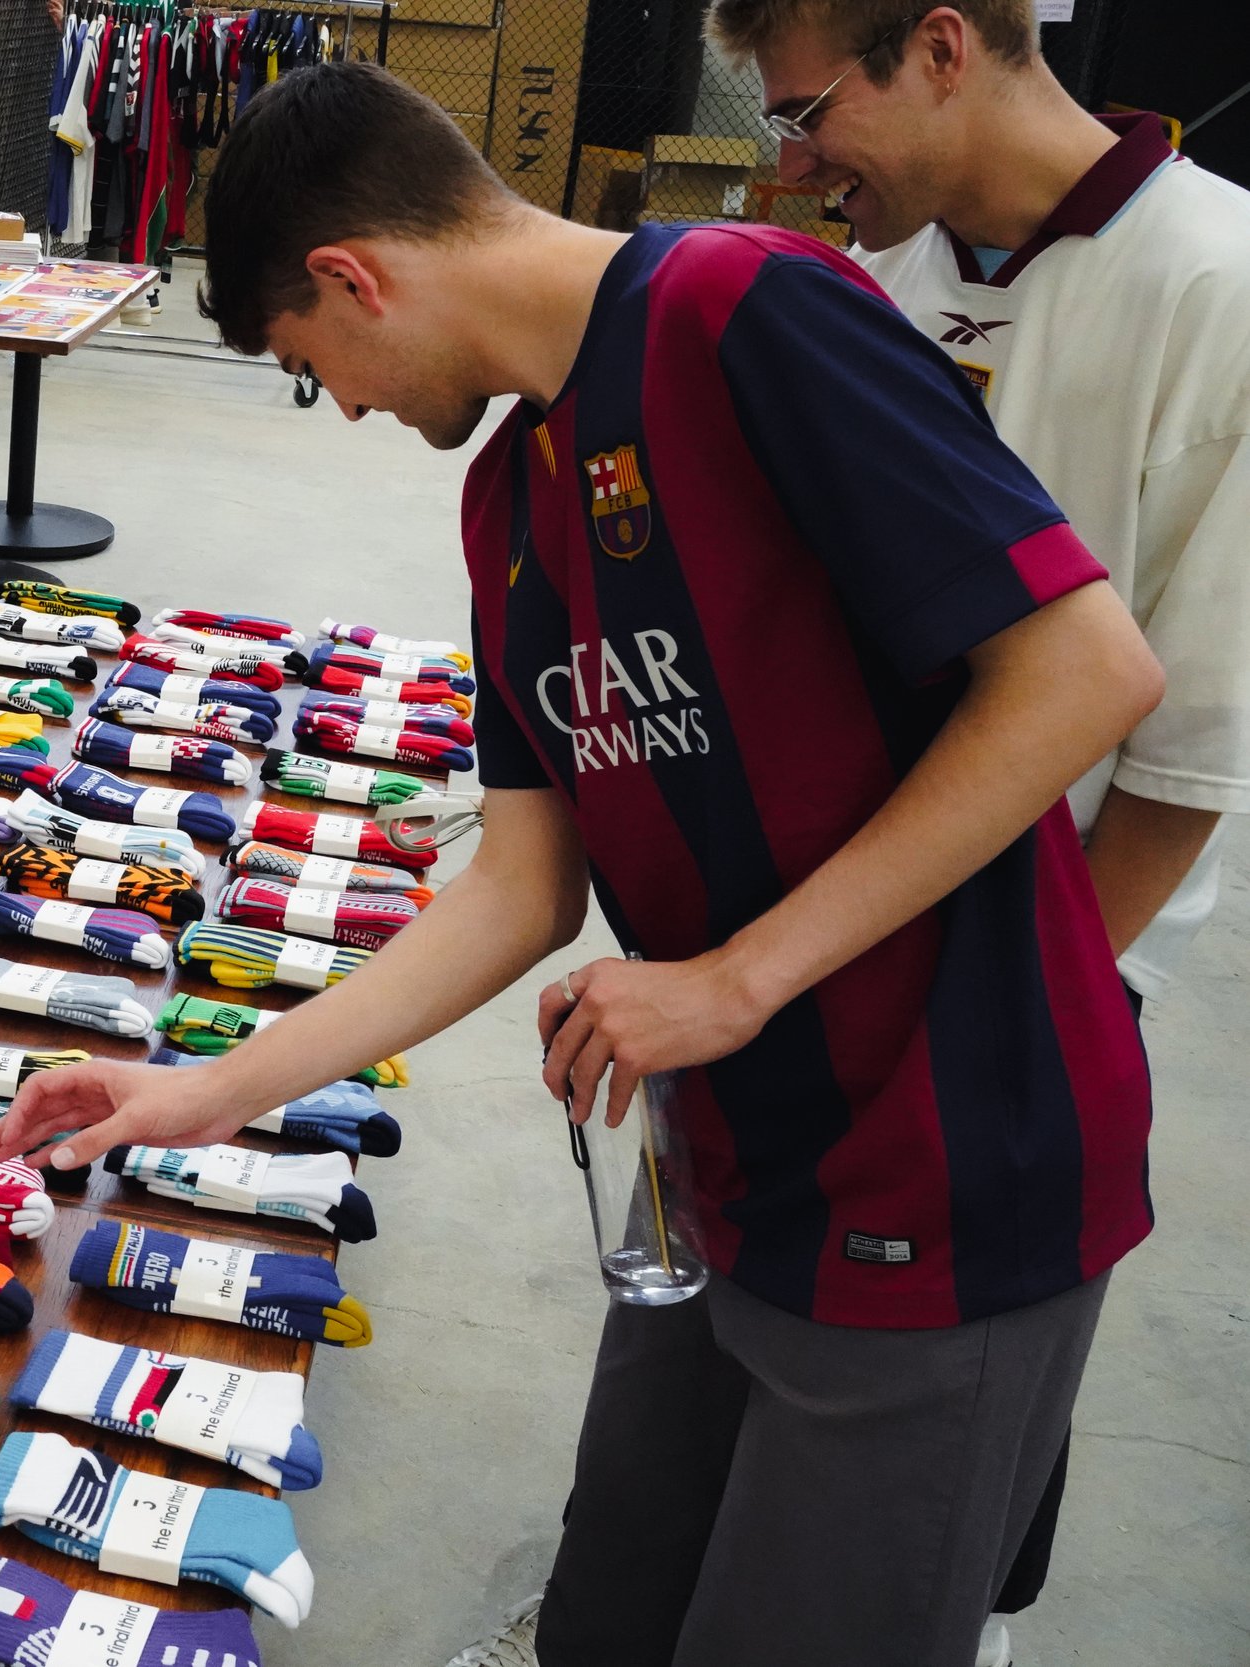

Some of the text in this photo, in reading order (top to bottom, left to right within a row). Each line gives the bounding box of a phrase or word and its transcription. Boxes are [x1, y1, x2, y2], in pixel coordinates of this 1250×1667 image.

[608, 494, 632, 512] FCB
[237, 1173, 250, 1185] the
[127, 1231, 141, 1258] ITALIA
[219, 1279, 233, 1298] the
[200, 1373, 241, 1439] the final third
[152, 1485, 187, 1550] the final third
[107, 1628, 131, 1655] final
[119, 1605, 140, 1630] third
